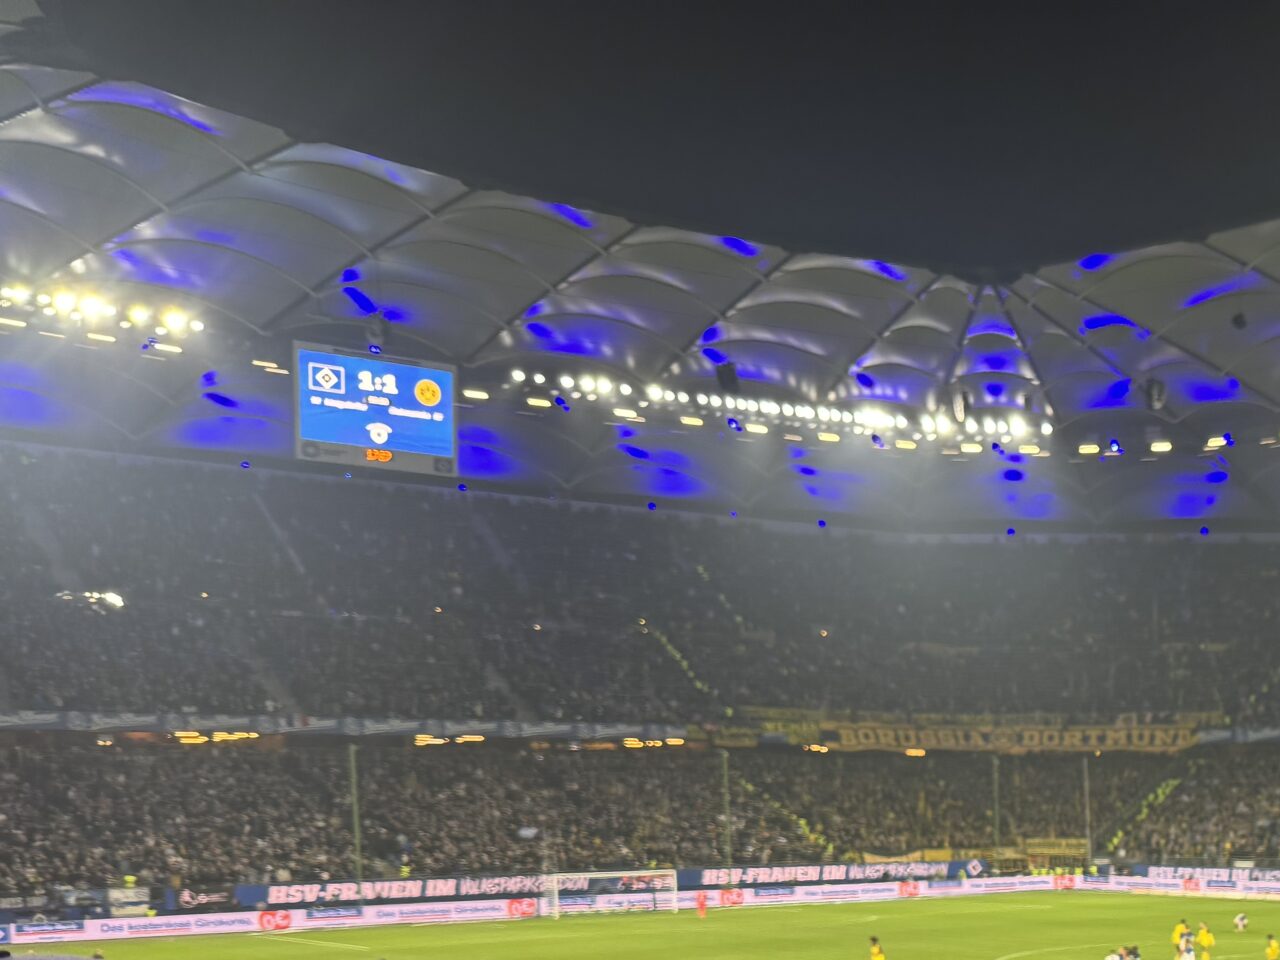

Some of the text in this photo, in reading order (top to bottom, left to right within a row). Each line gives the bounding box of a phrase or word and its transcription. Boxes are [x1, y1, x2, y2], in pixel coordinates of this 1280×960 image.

[839, 726, 1195, 748] BORUSSIA DORTMUND
[268, 880, 422, 904] HSV-FRAUEN
[425, 878, 456, 898] IM
[101, 922, 124, 934] Das
